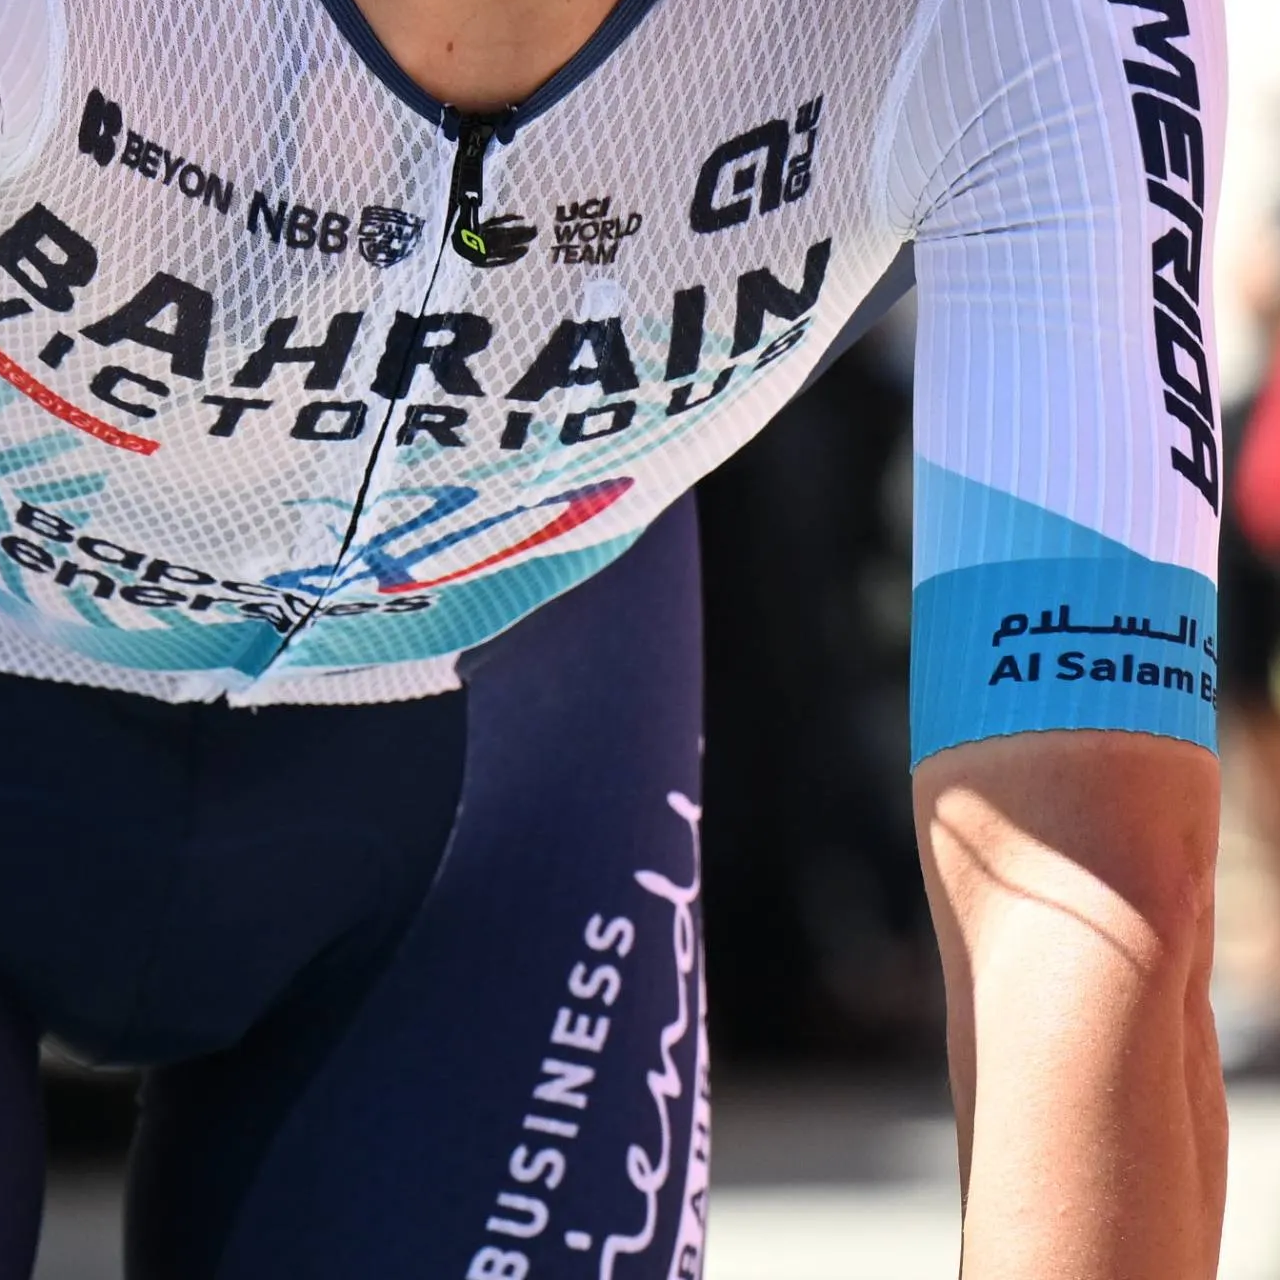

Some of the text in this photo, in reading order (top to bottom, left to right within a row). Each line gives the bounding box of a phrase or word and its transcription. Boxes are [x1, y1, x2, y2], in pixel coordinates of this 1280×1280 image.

[121, 130, 234, 215] BEYON
[247, 190, 351, 255] NBB
[553, 213, 643, 244] WORLD
[555, 195, 612, 222] UCI
[550, 241, 619, 266] TEAM
[0, 535, 434, 634] energes
[988, 652, 1041, 686] Al
[1055, 651, 1194, 694] Salam
[465, 913, 636, 1280] BUSINESS
